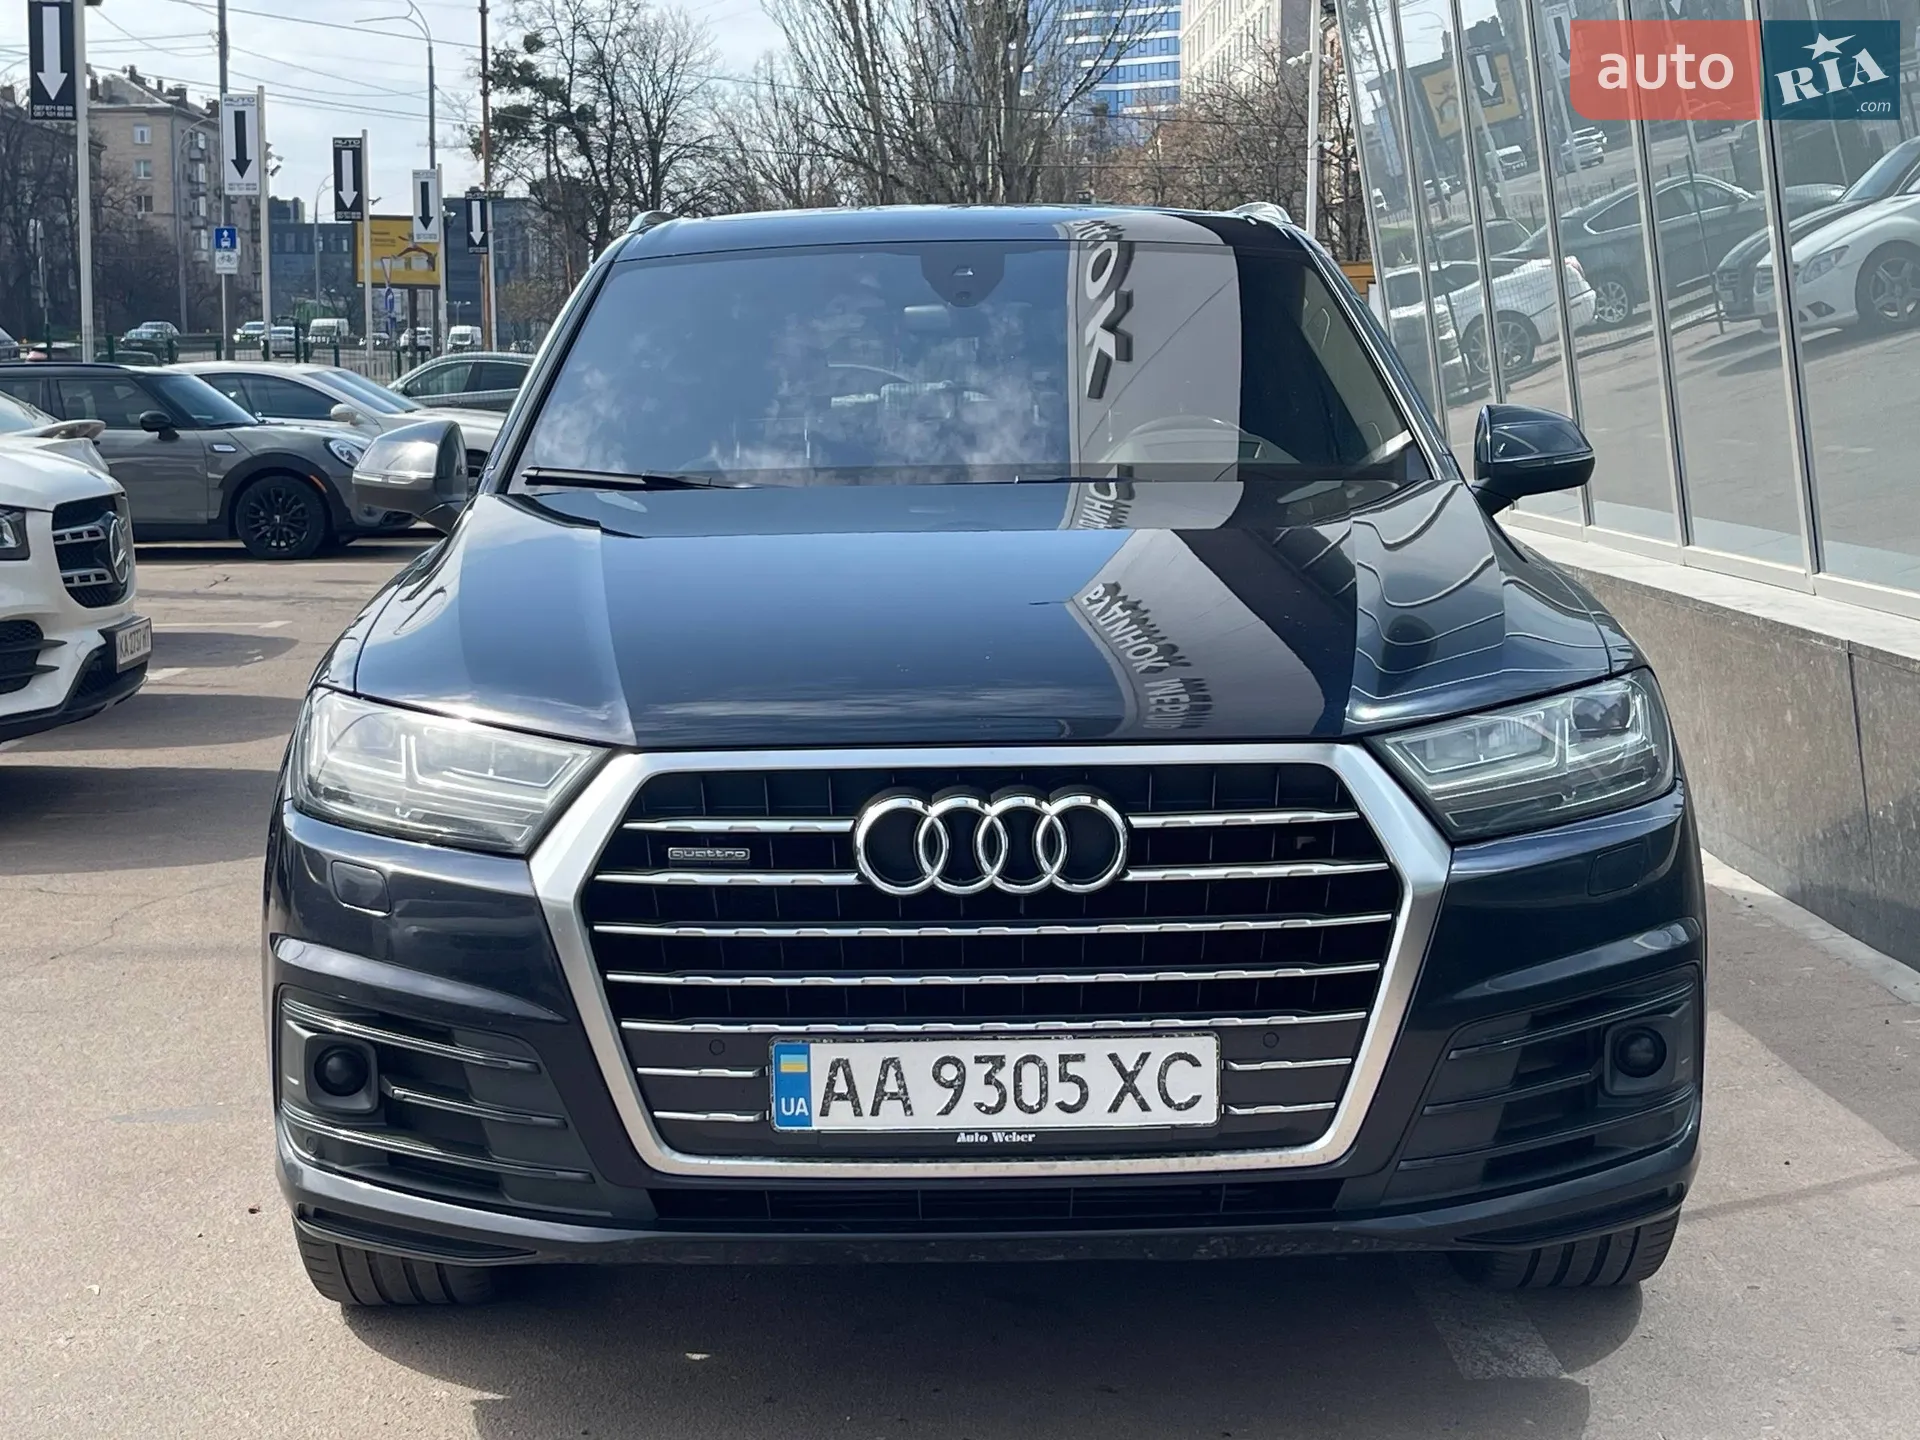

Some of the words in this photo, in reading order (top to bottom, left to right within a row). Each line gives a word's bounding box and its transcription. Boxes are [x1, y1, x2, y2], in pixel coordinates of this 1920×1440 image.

[672, 850, 746, 859] quattro
[819, 1056, 914, 1117] AA
[931, 1053, 1090, 1116] 9305
[1106, 1051, 1203, 1114] XC
[781, 1097, 809, 1117] UA
[956, 1132, 988, 1143] Auto
[992, 1132, 1036, 1143] Weber
